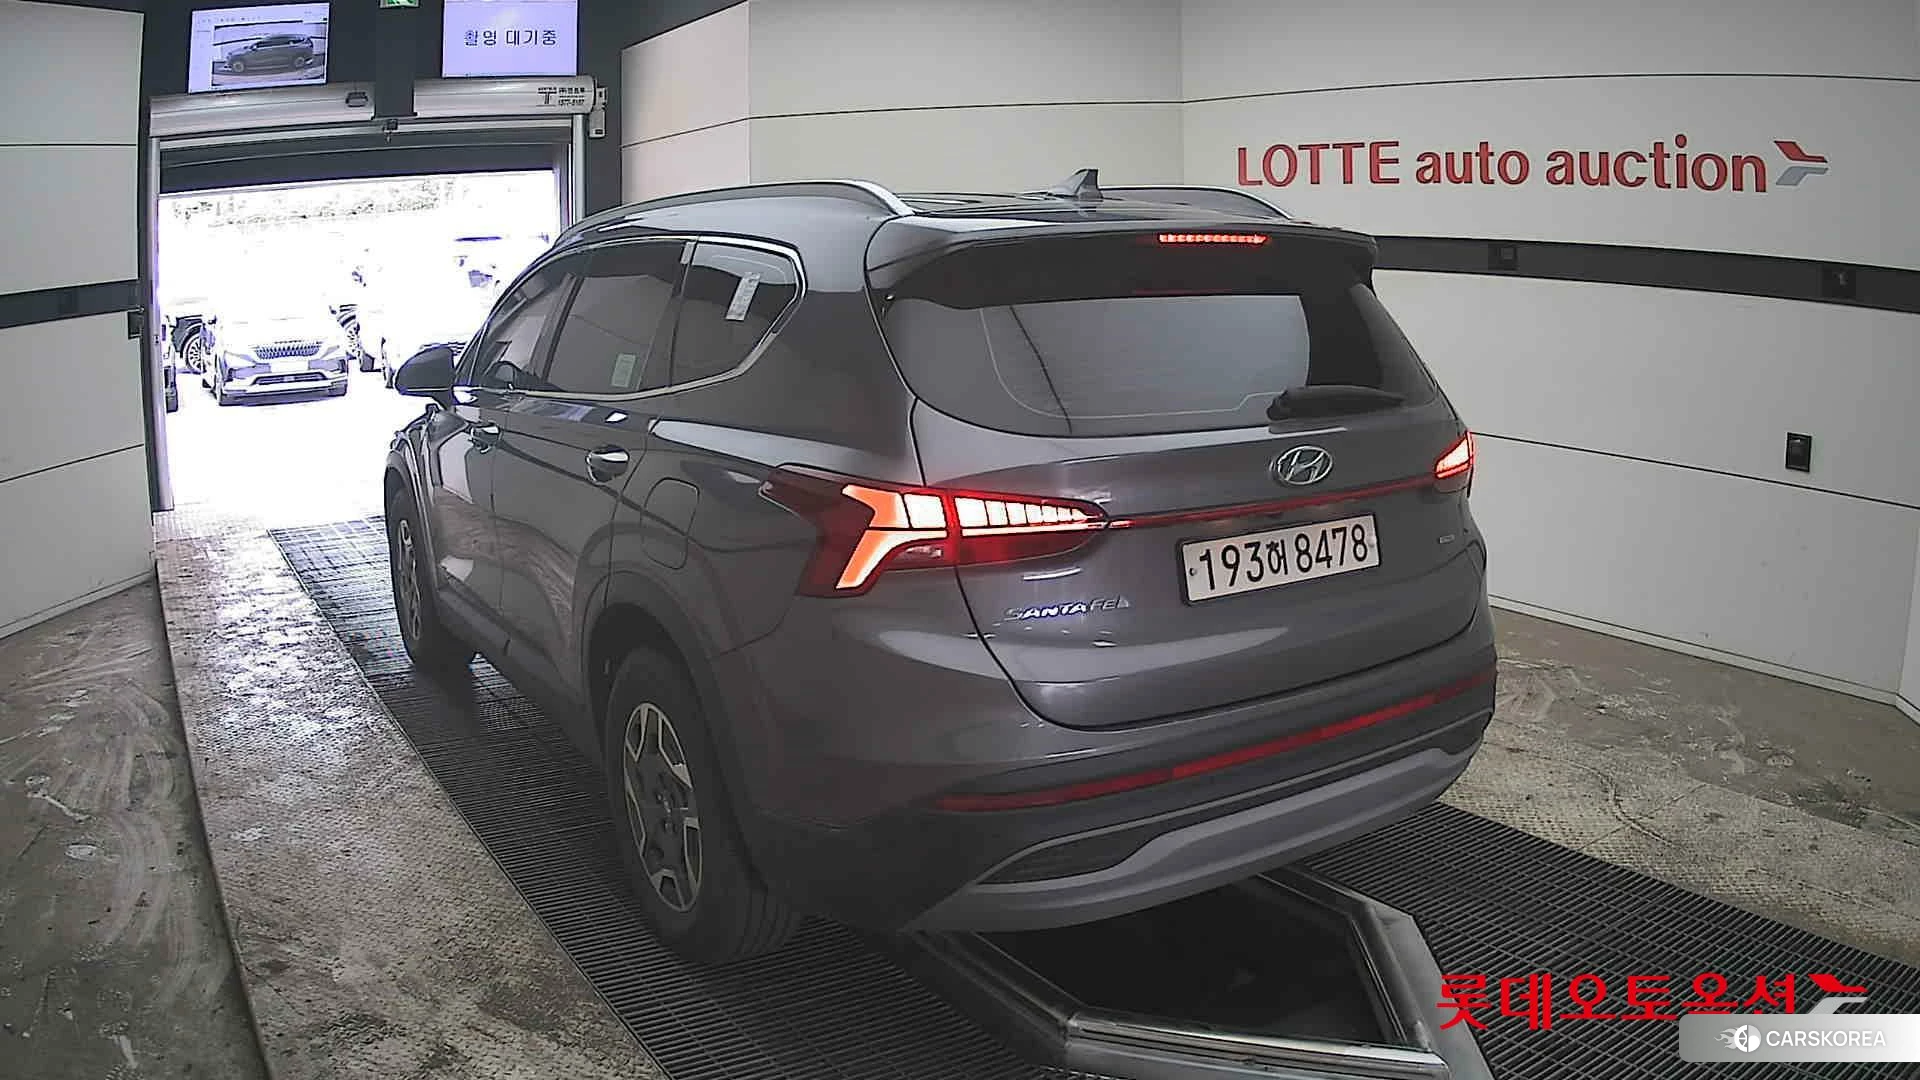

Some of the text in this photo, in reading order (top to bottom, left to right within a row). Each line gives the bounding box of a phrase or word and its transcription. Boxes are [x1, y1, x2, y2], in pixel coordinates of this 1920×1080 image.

[506, 29, 557, 46] 대기중
[1237, 134, 1768, 193] LOTTE auto auction
